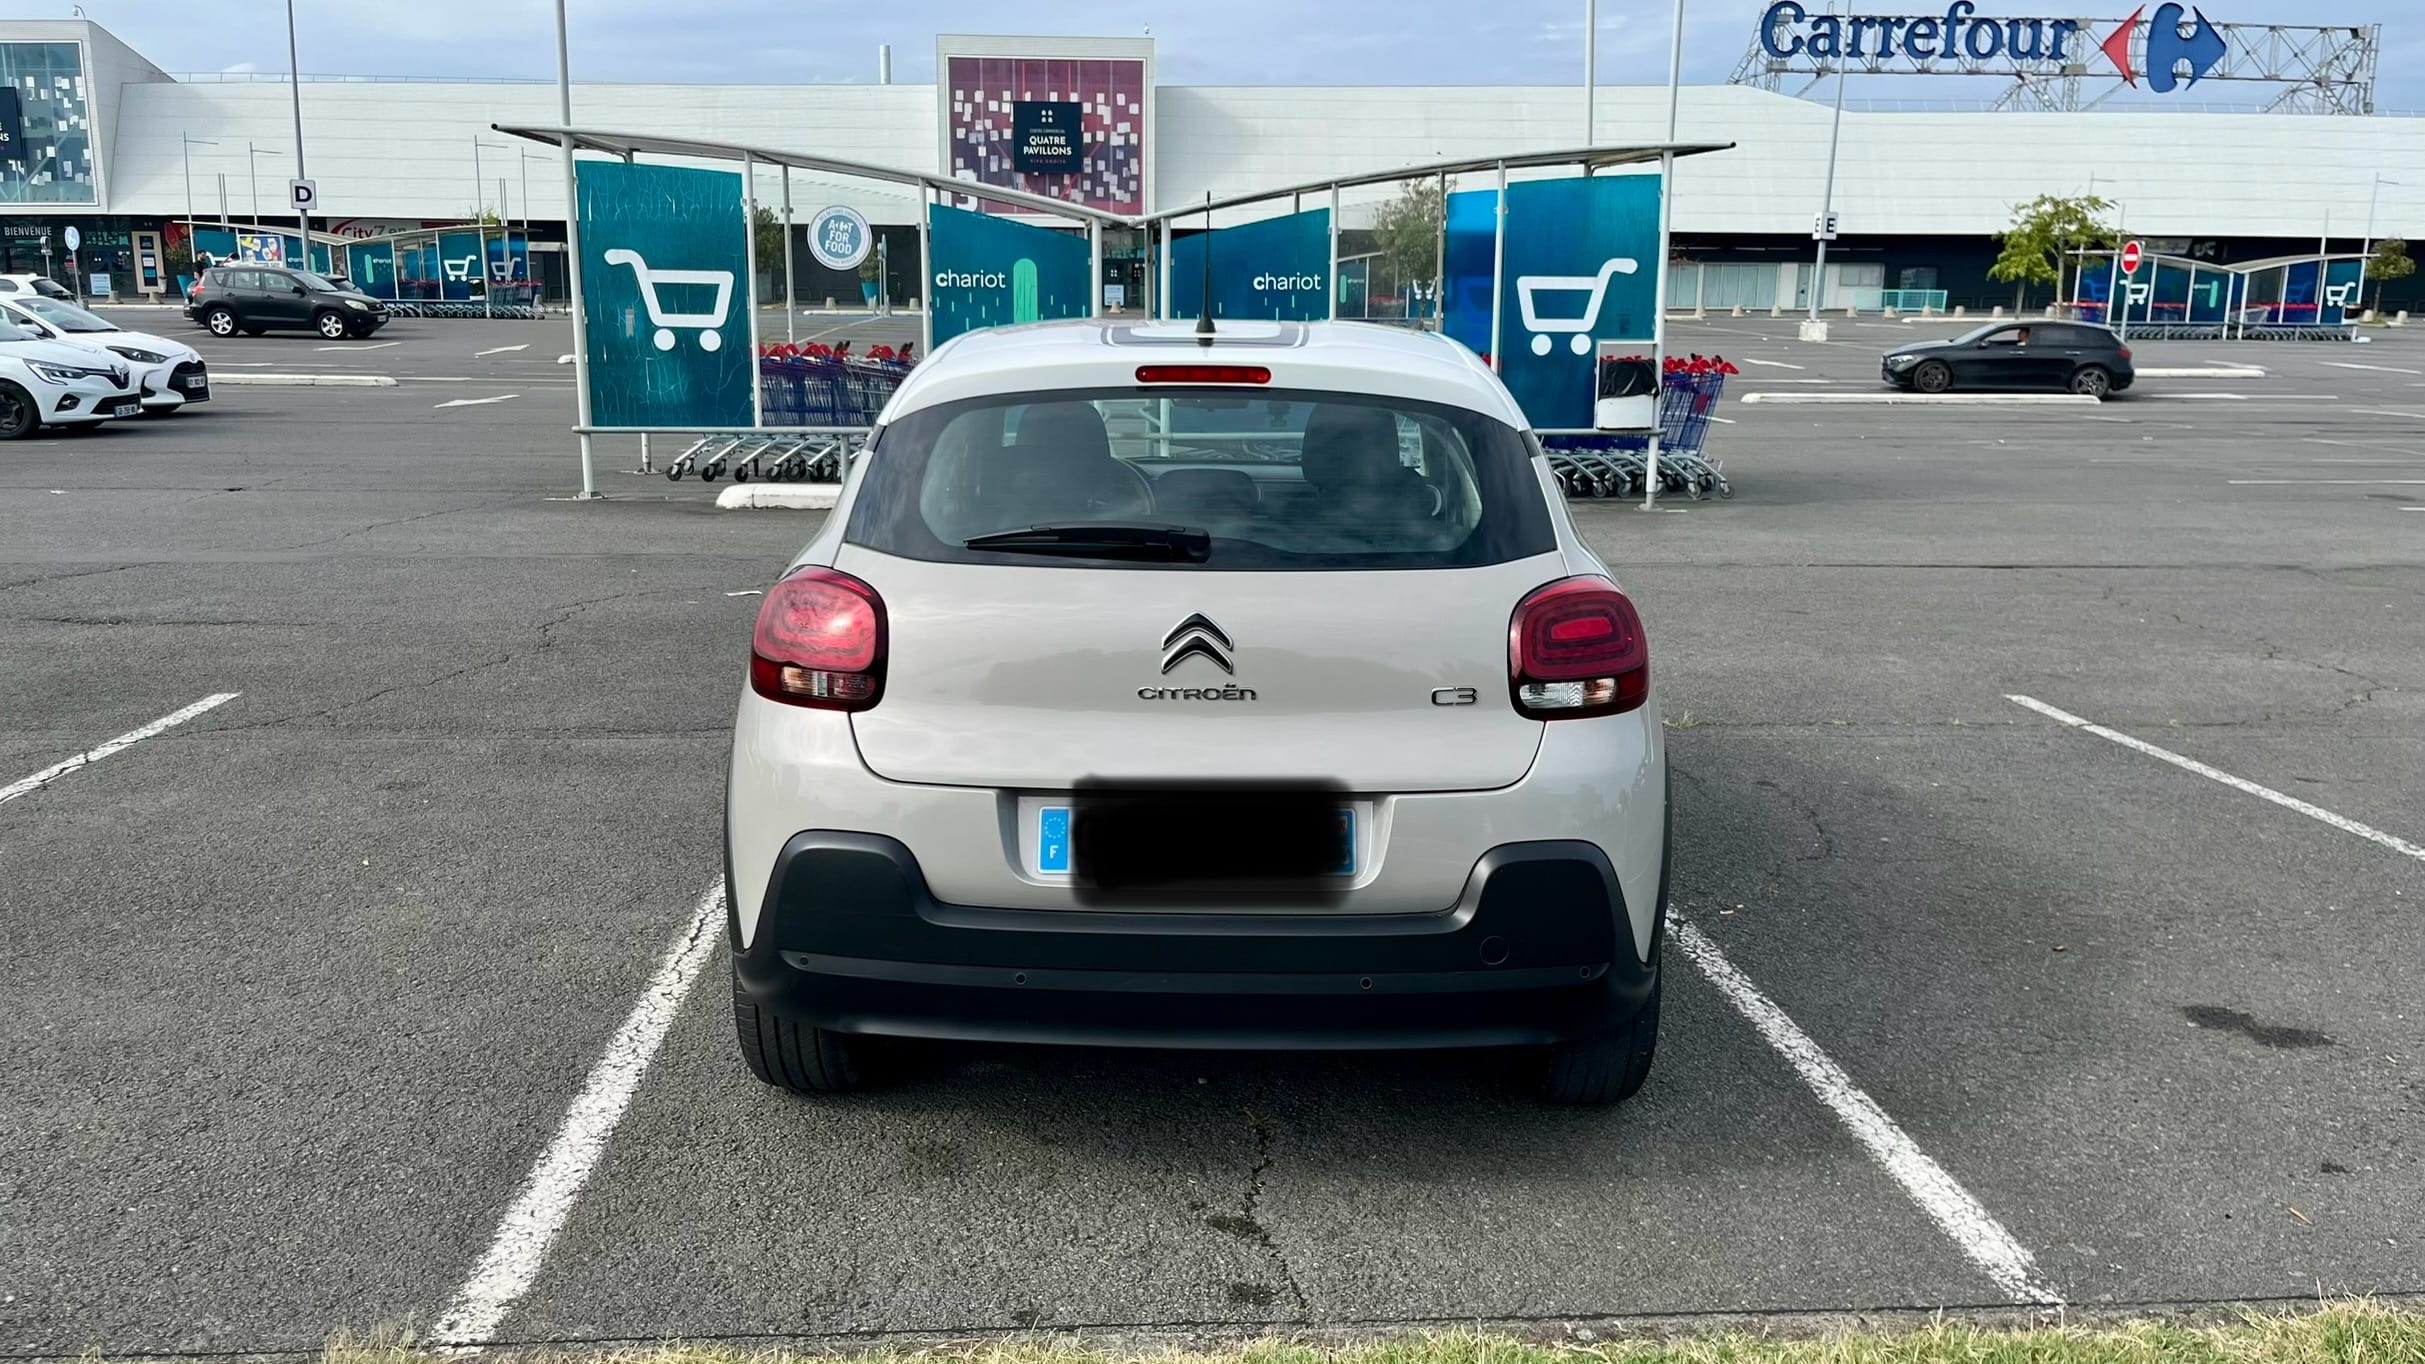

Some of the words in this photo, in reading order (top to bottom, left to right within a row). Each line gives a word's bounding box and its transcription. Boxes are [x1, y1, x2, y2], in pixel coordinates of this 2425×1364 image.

[1760, 0, 2077, 60] Carrefour
[1029, 135, 1066, 145] QUATRE
[1023, 146, 1072, 155] PAVILLONS
[294, 185, 313, 204] D
[4, 226, 52, 236] BIENVENUE
[1826, 217, 1836, 233] E
[829, 230, 850, 243] FOR
[824, 240, 852, 255] FOOD
[935, 268, 1006, 289] chariot
[1253, 271, 1322, 291] chariot
[1431, 687, 1478, 706] C3
[1049, 844, 1060, 860] F
